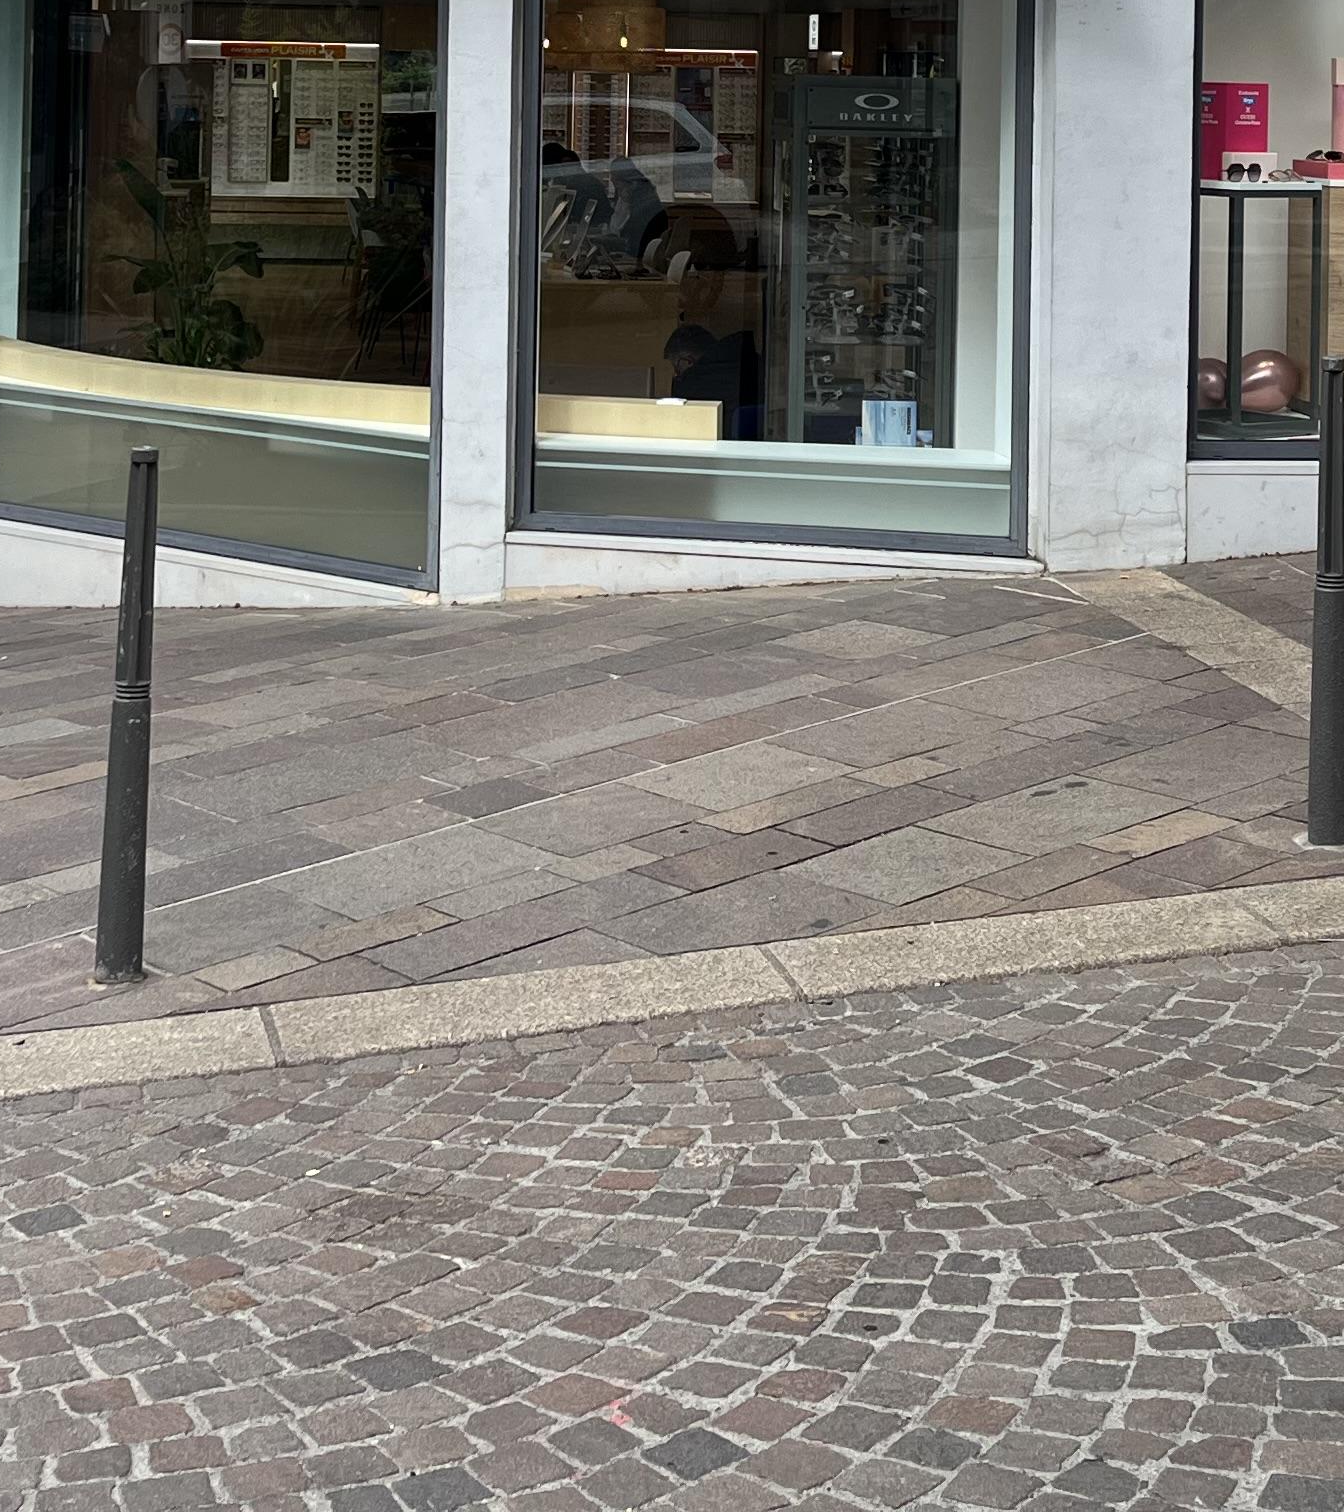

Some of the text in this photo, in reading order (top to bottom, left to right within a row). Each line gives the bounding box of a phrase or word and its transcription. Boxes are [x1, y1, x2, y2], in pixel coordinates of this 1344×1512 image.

[271, 45, 317, 56] PLAISIR
[682, 54, 728, 65] PLAISIR
[839, 112, 913, 122] OAKLEY
